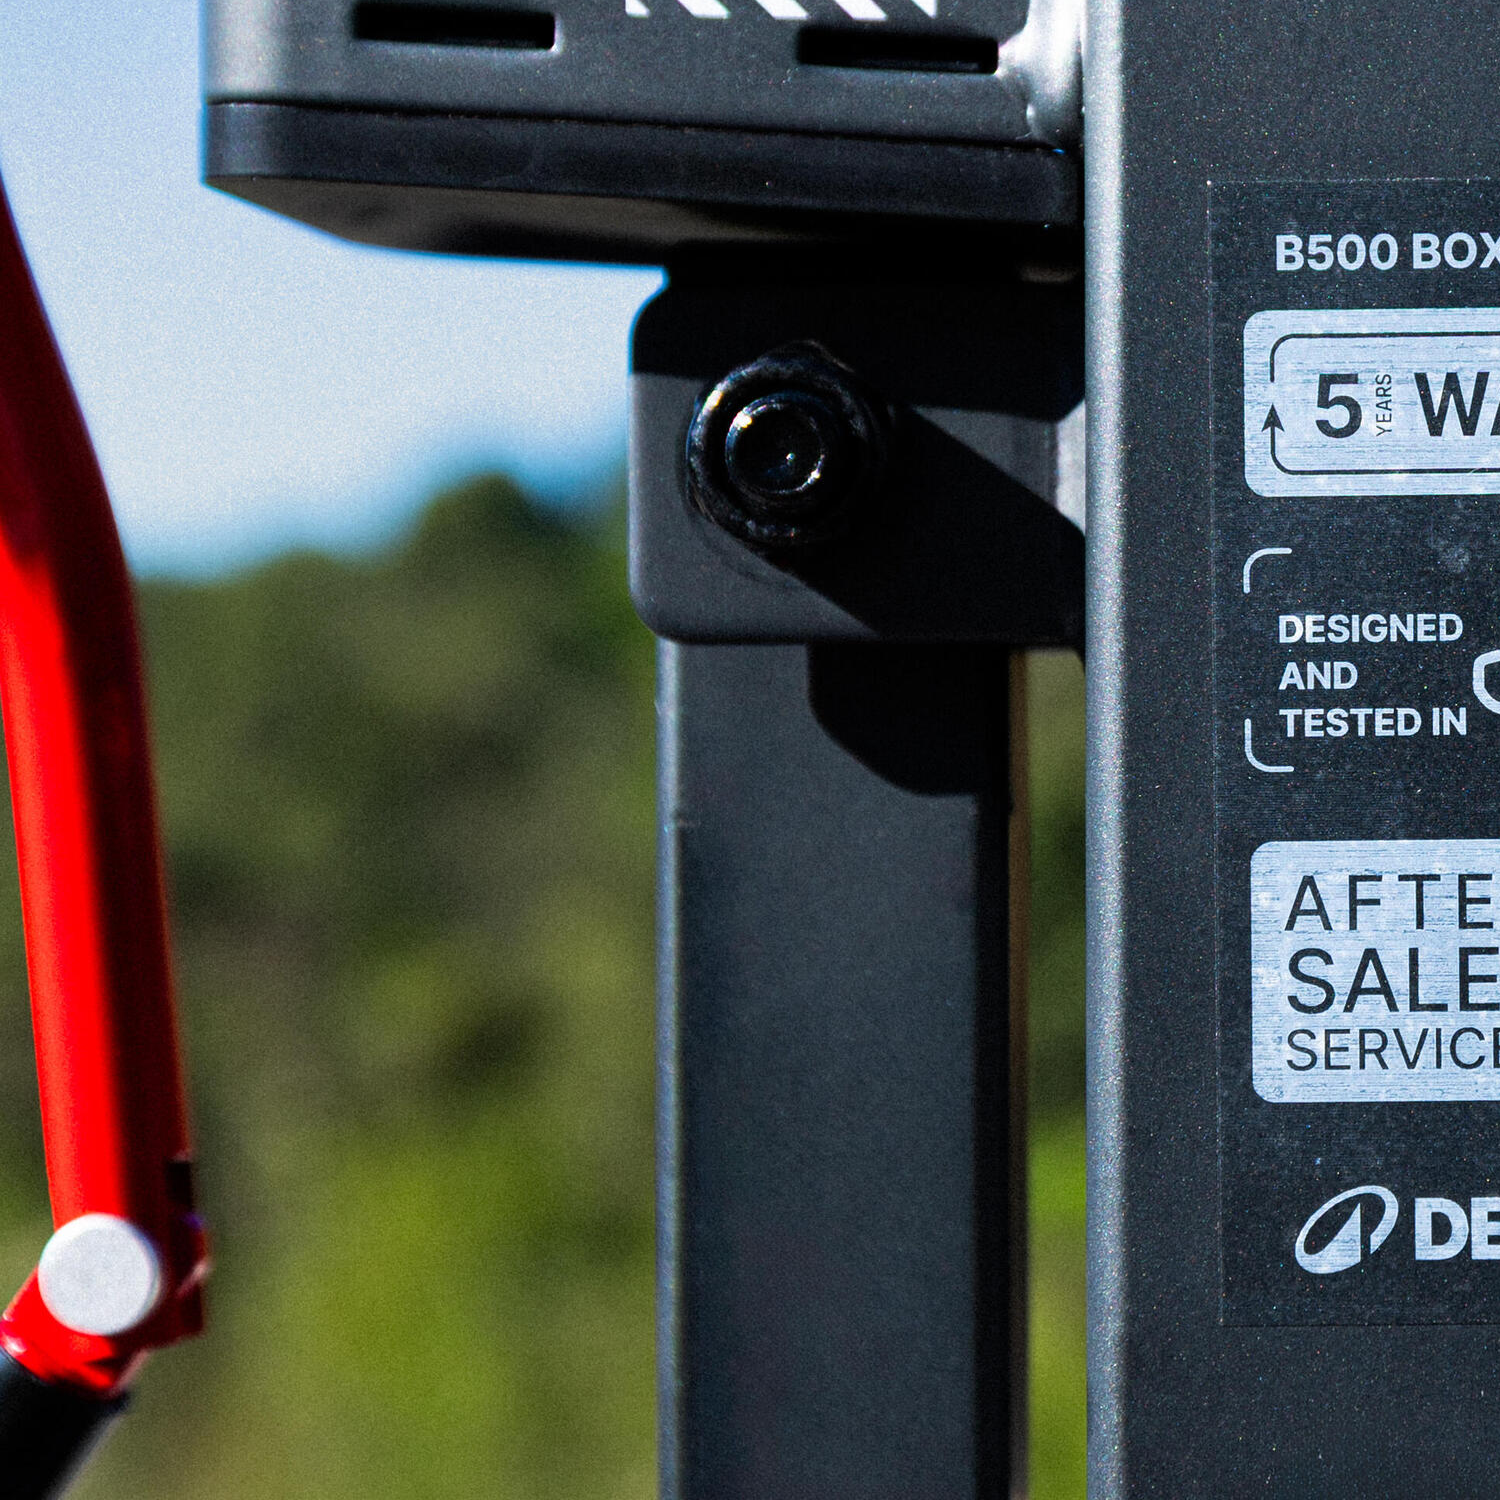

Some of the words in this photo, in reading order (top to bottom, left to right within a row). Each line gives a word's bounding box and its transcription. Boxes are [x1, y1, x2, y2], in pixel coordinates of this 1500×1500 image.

[1275, 233, 1399, 271] B500
[1315, 373, 1363, 439] 5
[1375, 373, 1393, 437] YEARS
[1278, 613, 1463, 643] DESIGNED
[1279, 662, 1358, 690] AND
[1280, 707, 1425, 738] TESTED
[1432, 706, 1468, 736] IN
